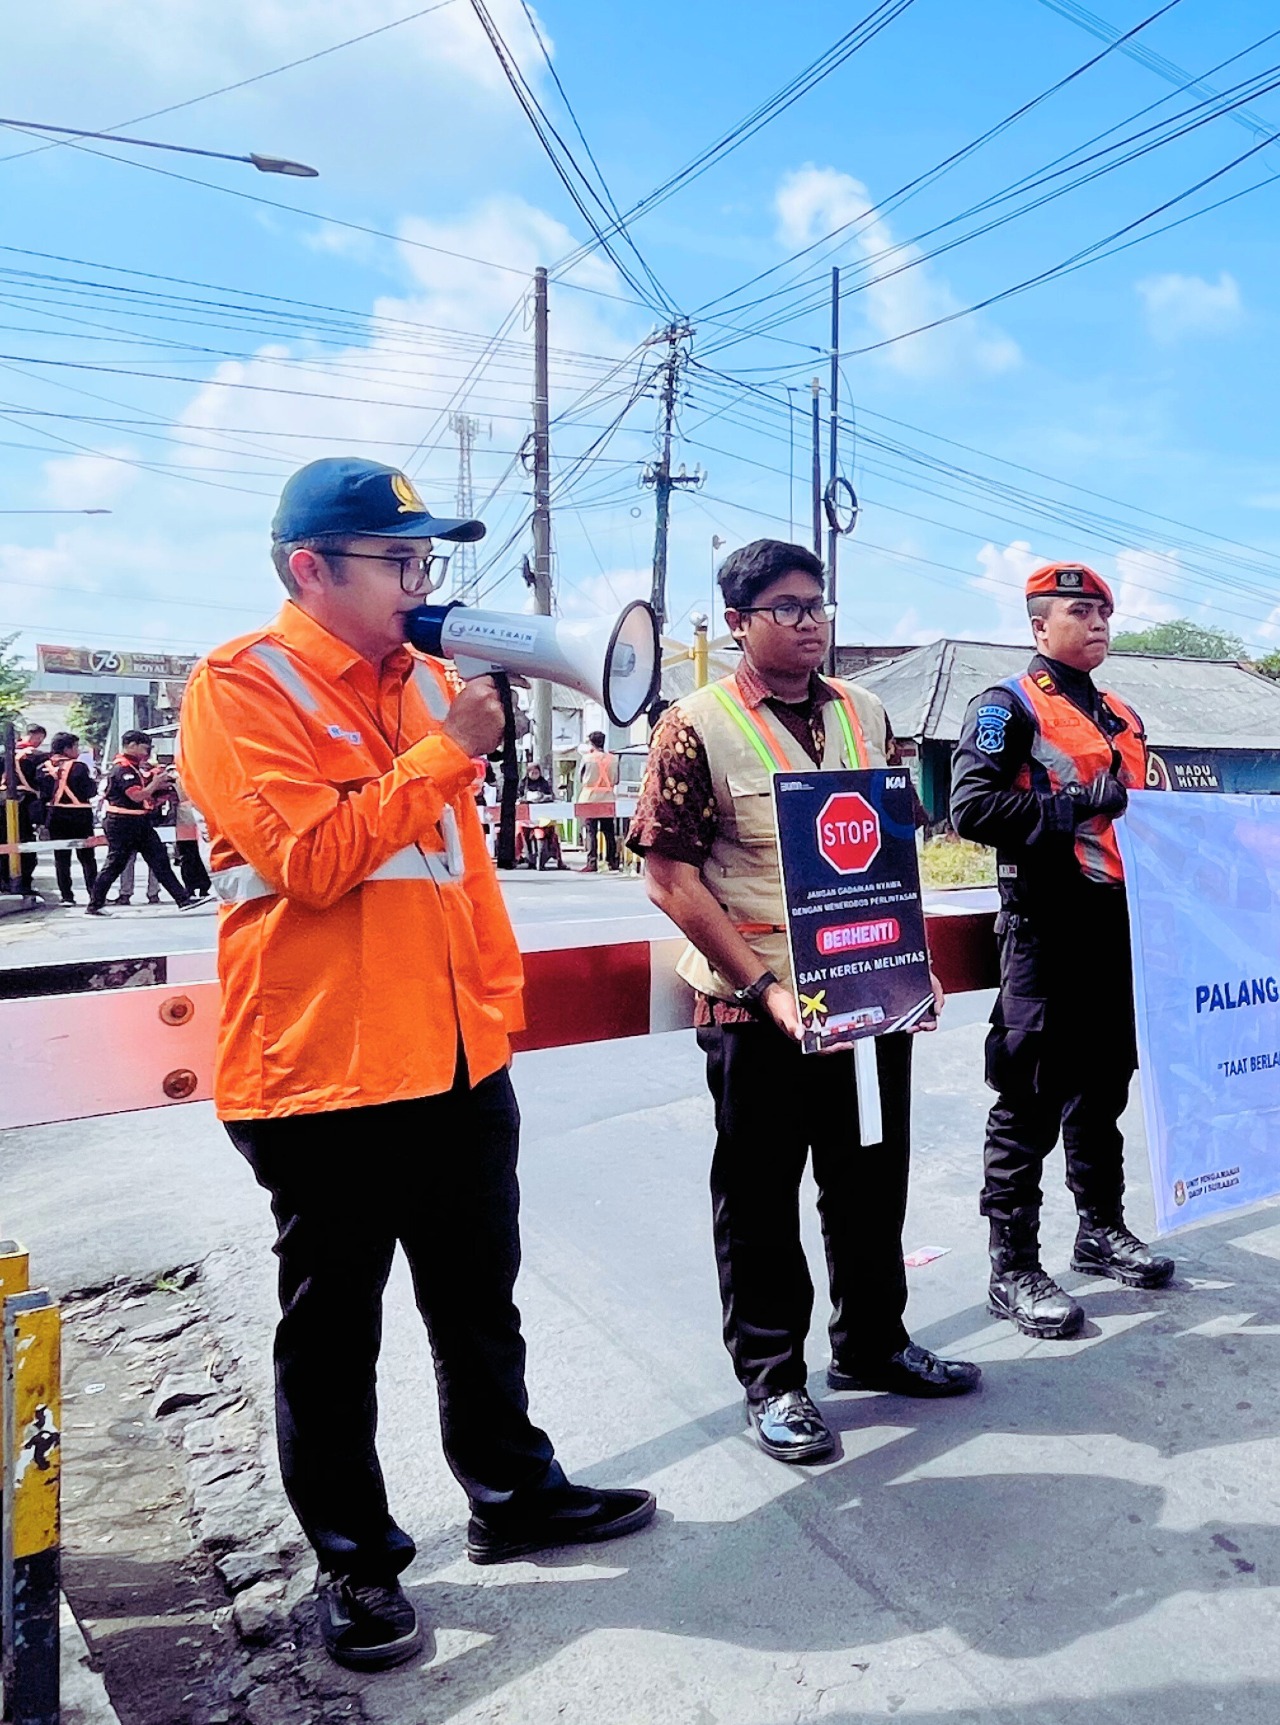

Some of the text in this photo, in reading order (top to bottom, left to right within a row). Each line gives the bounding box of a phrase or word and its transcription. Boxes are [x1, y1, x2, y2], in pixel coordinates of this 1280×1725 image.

[468, 625, 496, 635] JAVA
[500, 630, 532, 641] TRAIN
[93, 650, 118, 672] 76
[1175, 765, 1211, 776] MADU
[885, 776, 906, 789] KAI
[1178, 776, 1218, 788] HITAM
[823, 820, 875, 847] STOP
[792, 892, 918, 917] DENGAN MENEROBOS PERLINTASAN
[807, 888, 836, 900] JANGAN
[823, 921, 894, 950] BERHENTI
[799, 951, 926, 985] SAAT KERETA MELINTAS
[1195, 977, 1279, 1013] PALANG
